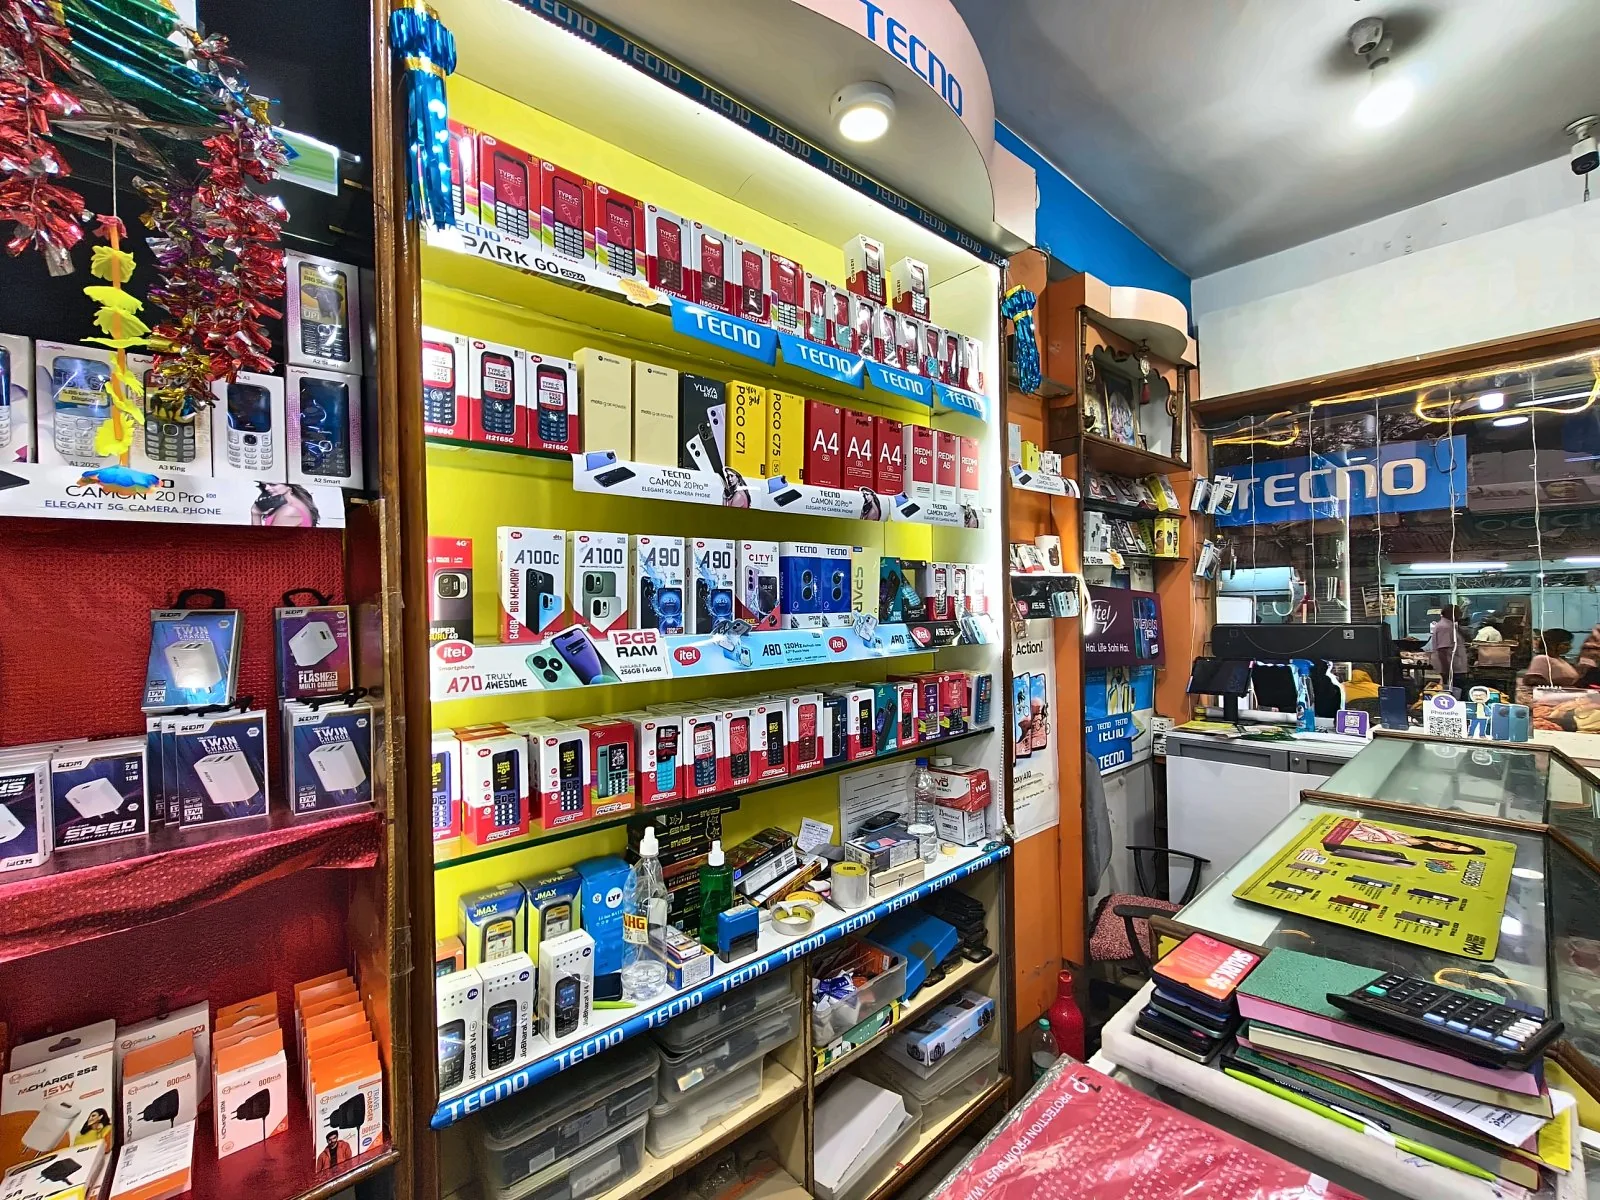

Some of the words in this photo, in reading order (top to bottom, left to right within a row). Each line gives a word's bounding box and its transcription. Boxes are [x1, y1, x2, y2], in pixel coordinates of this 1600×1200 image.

[619, 37, 681, 84] TECNO
[859, 0, 964, 117] TECNO
[701, 85, 751, 124] TECNO
[767, 122, 811, 158] TECNO
[499, 169, 522, 184] TYPE-C
[825, 157, 863, 186] TECNO
[558, 189, 579, 203] TYPE-C
[875, 186, 908, 210] TECNO
[610, 213, 629, 225] TYPE-C
[919, 209, 948, 233] TECNO
[660, 229, 677, 240] TYPE-C
[956, 231, 982, 254] TECNO
[461, 234, 529, 268] PARK
[535, 258, 559, 274] GO
[561, 269, 586, 281] 2024
[688, 307, 761, 349] TECNO
[796, 342, 851, 374] TECNO
[693, 383, 717, 395] YUVA
[880, 368, 924, 396] TECNO
[736, 385, 746, 427] POCO
[772, 393, 782, 430] POCO
[485, 434, 514, 443] it2165C
[736, 432, 746, 455] C71
[772, 433, 781, 456] C75
[813, 429, 839, 455] A4
[543, 442, 568, 451] it2165C
[846, 436, 872, 461] A4
[914, 447, 932, 457] REDMI
[879, 443, 902, 466] A4
[919, 457, 928, 465] A5
[937, 452, 955, 461] REDMI
[961, 456, 978, 466] REDMI
[942, 462, 951, 470] A5
[661, 469, 691, 479] TECNO
[648, 477, 681, 488] CAMON
[683, 481, 693, 490] 20
[693, 482, 704, 491] Pro
[1233, 457, 1426, 510] TECNO
[155, 490, 176, 502] 20
[178, 492, 204, 503] Pro
[674, 489, 694, 497] CAMERA
[820, 490, 841, 498] TECNO
[45, 500, 103, 510] ELEGANT
[108, 503, 124, 511] 5G
[128, 504, 178, 514] CAMERA
[182, 507, 222, 515] PHONE
[811, 497, 833, 505] CAMON
[515, 549, 560, 565] A100c
[582, 547, 623, 565] A100
[645, 547, 680, 567] A90
[795, 545, 818, 554] TECNO
[826, 548, 848, 556] TECNO
[701, 551, 731, 569] A90
[749, 554, 770, 562] CITY
[510, 567, 519, 597] MEMORY
[510, 598, 519, 613] BIG
[1091, 604, 1111, 622] itel
[173, 626, 208, 635] TWIN
[509, 619, 519, 639] 64GB
[614, 632, 657, 645] 12GB
[784, 642, 803, 650] 120Hz
[832, 640, 845, 649] itel
[443, 647, 466, 658] itel
[617, 645, 658, 658] RAM
[678, 649, 697, 660] itel
[763, 643, 782, 657] A80
[1016, 641, 1043, 656] Action!
[1085, 642, 1097, 652] Hai.
[1108, 643, 1119, 652] Sahi
[439, 664, 475, 672] Smartphone
[299, 672, 326, 683] FLASH
[326, 673, 337, 681] 25
[447, 676, 482, 694] A70
[485, 679, 528, 690] AWESOME
[1097, 721, 1112, 729] TECNO
[1115, 717, 1129, 725] TECNO
[314, 727, 348, 737] TWIN
[320, 734, 351, 743] CHARGE
[199, 736, 237, 747] TWIN
[205, 744, 240, 753] CHARGE
[58, 760, 82, 768] KDM
[1099, 749, 1125, 770] TECNO
[65, 819, 137, 839] SPEED
[965, 857, 992, 876] TECNO
[928, 873, 958, 893] TECNO
[534, 889, 557, 900] JMAX
[608, 893, 621, 902] LYF
[886, 890, 920, 913] TECNO
[473, 904, 498, 917] JMAX
[837, 911, 876, 937] TECNO
[782, 935, 826, 963] TECNO
[1215, 949, 1254, 980] SHARK
[520, 972, 529, 980] Jio
[719, 960, 769, 993] TECNO
[467, 990, 478, 998] Jio
[644, 991, 703, 1029] TECNO
[469, 1032, 476, 1042] V4
[554, 1027, 624, 1071] TECNO
[469, 1043, 477, 1080] JioBharat
[77, 1065, 98, 1076] 252
[166, 1073, 191, 1087] 800mA
[258, 1073, 282, 1087] 800mA
[43, 1081, 75, 1097] 15W
[445, 1071, 529, 1121] TECNO
[1026, 1093, 1073, 1140] PROTECTION
[1001, 1136, 1032, 1166] FROM
